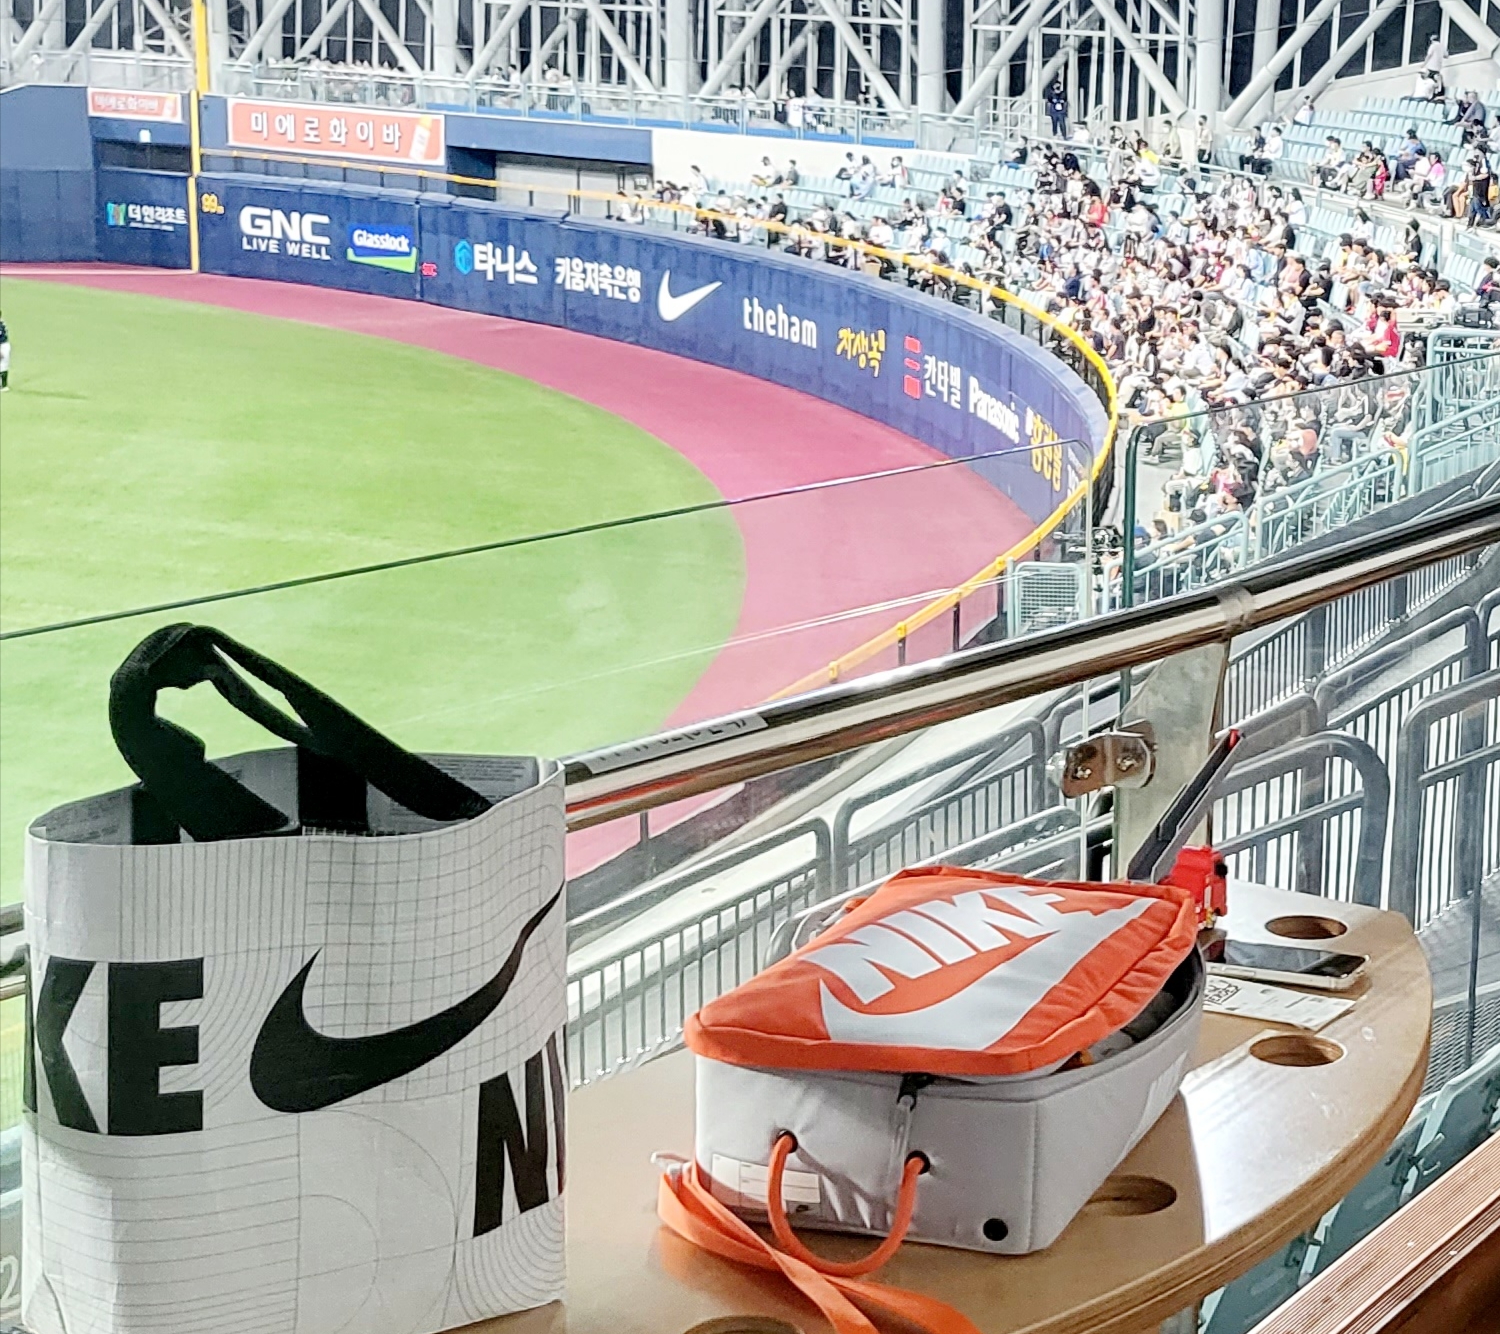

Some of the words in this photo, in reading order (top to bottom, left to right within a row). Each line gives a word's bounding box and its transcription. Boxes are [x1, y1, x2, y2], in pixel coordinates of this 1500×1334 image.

[251, 112, 402, 152] 미에로화이바
[240, 205, 331, 245] GNC
[242, 236, 280, 254] LIVE
[286, 241, 331, 261] WELL
[353, 228, 410, 253] Glasslock
[474, 241, 538, 285] 타니스
[554, 257, 641, 304] 키움저축은행
[743, 296, 817, 349] theham
[924, 354, 961, 409] 칸타빌
[969, 375, 1020, 444] Panasonic
[798, 886, 1066, 1005] NIKE
[24, 944, 204, 1136] KE
